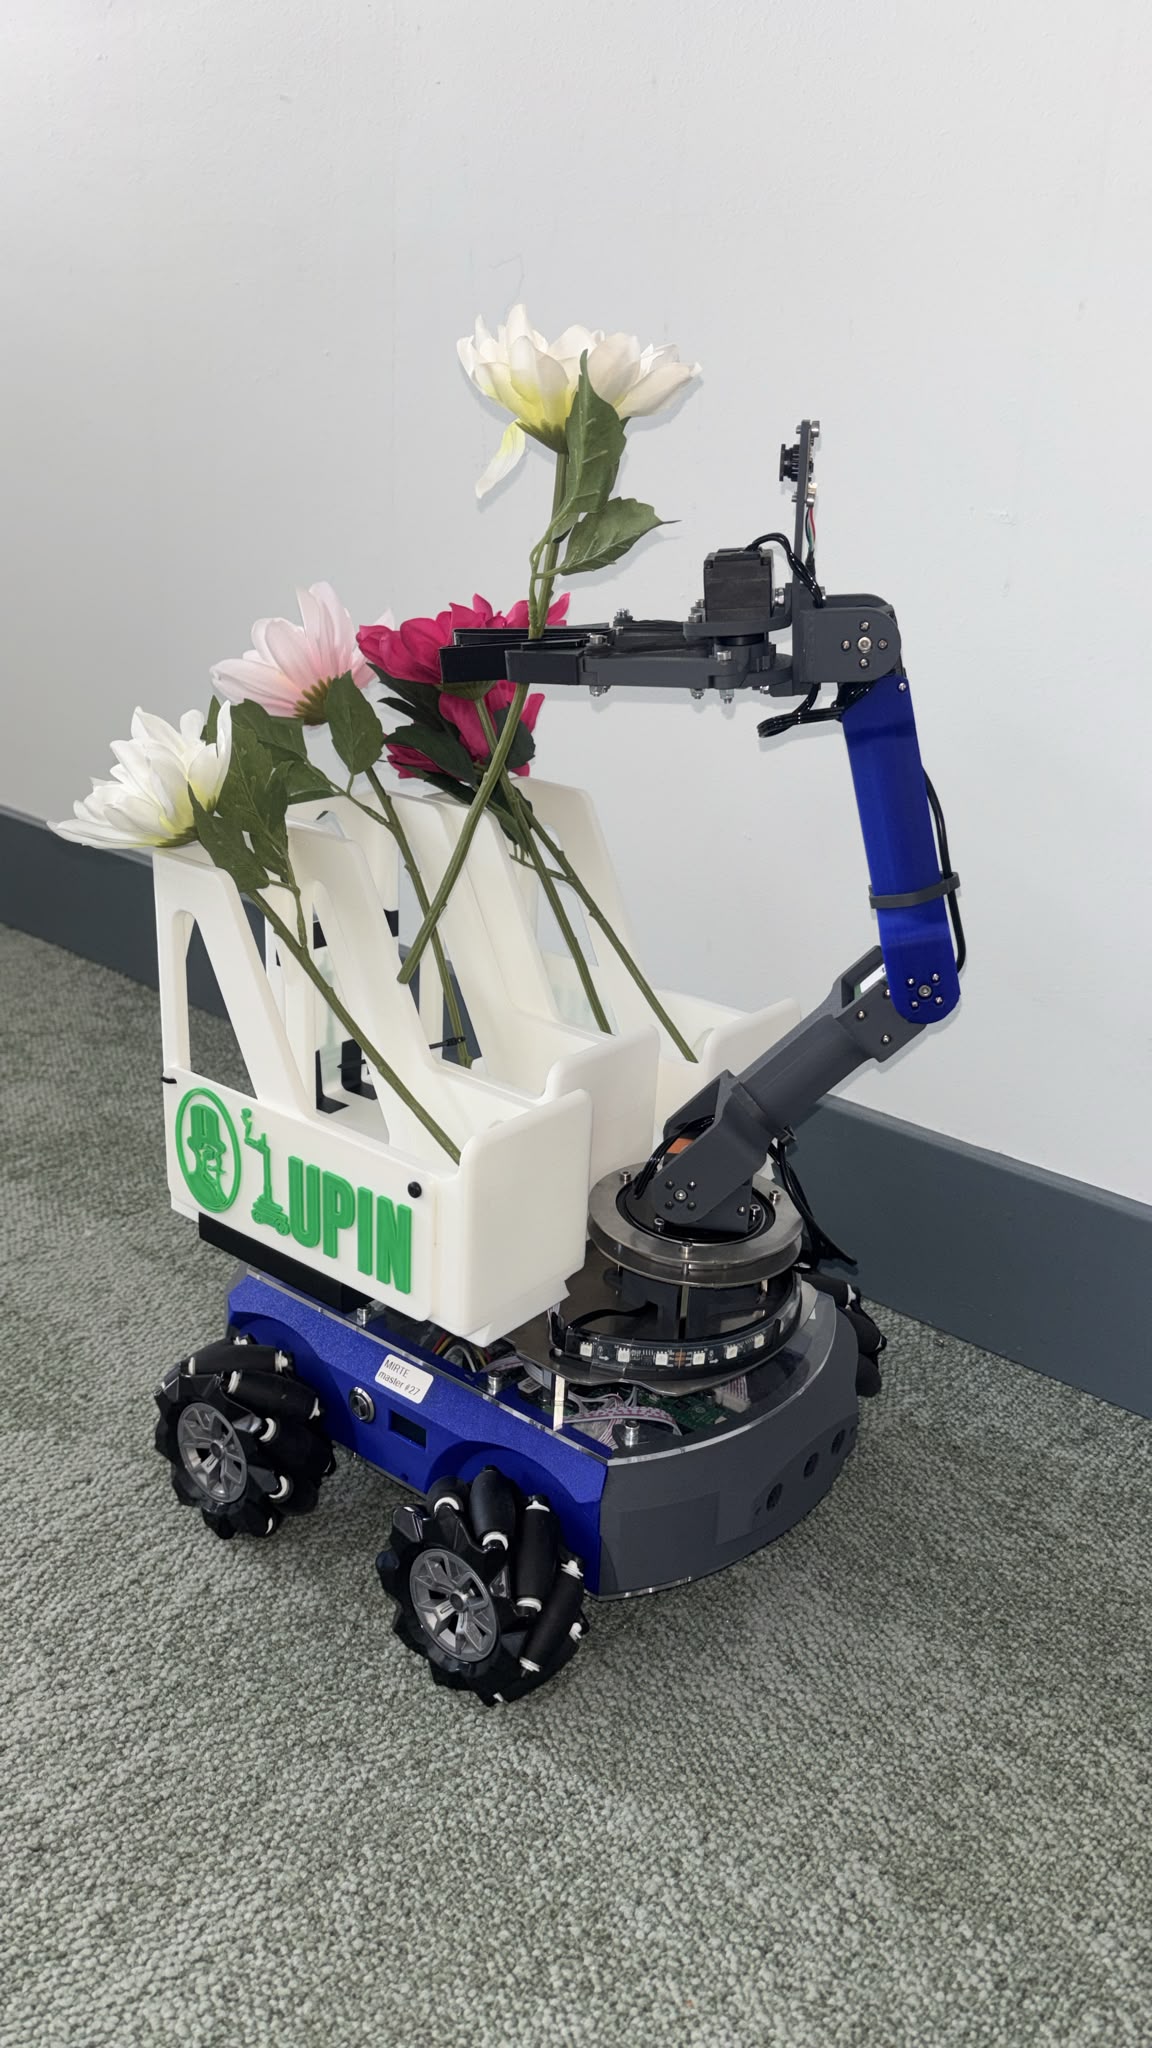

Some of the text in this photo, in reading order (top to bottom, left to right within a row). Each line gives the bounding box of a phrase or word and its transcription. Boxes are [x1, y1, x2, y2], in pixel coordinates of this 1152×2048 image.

[384, 1360, 410, 1378] MIRTE
[378, 1371, 421, 1396] master #27
